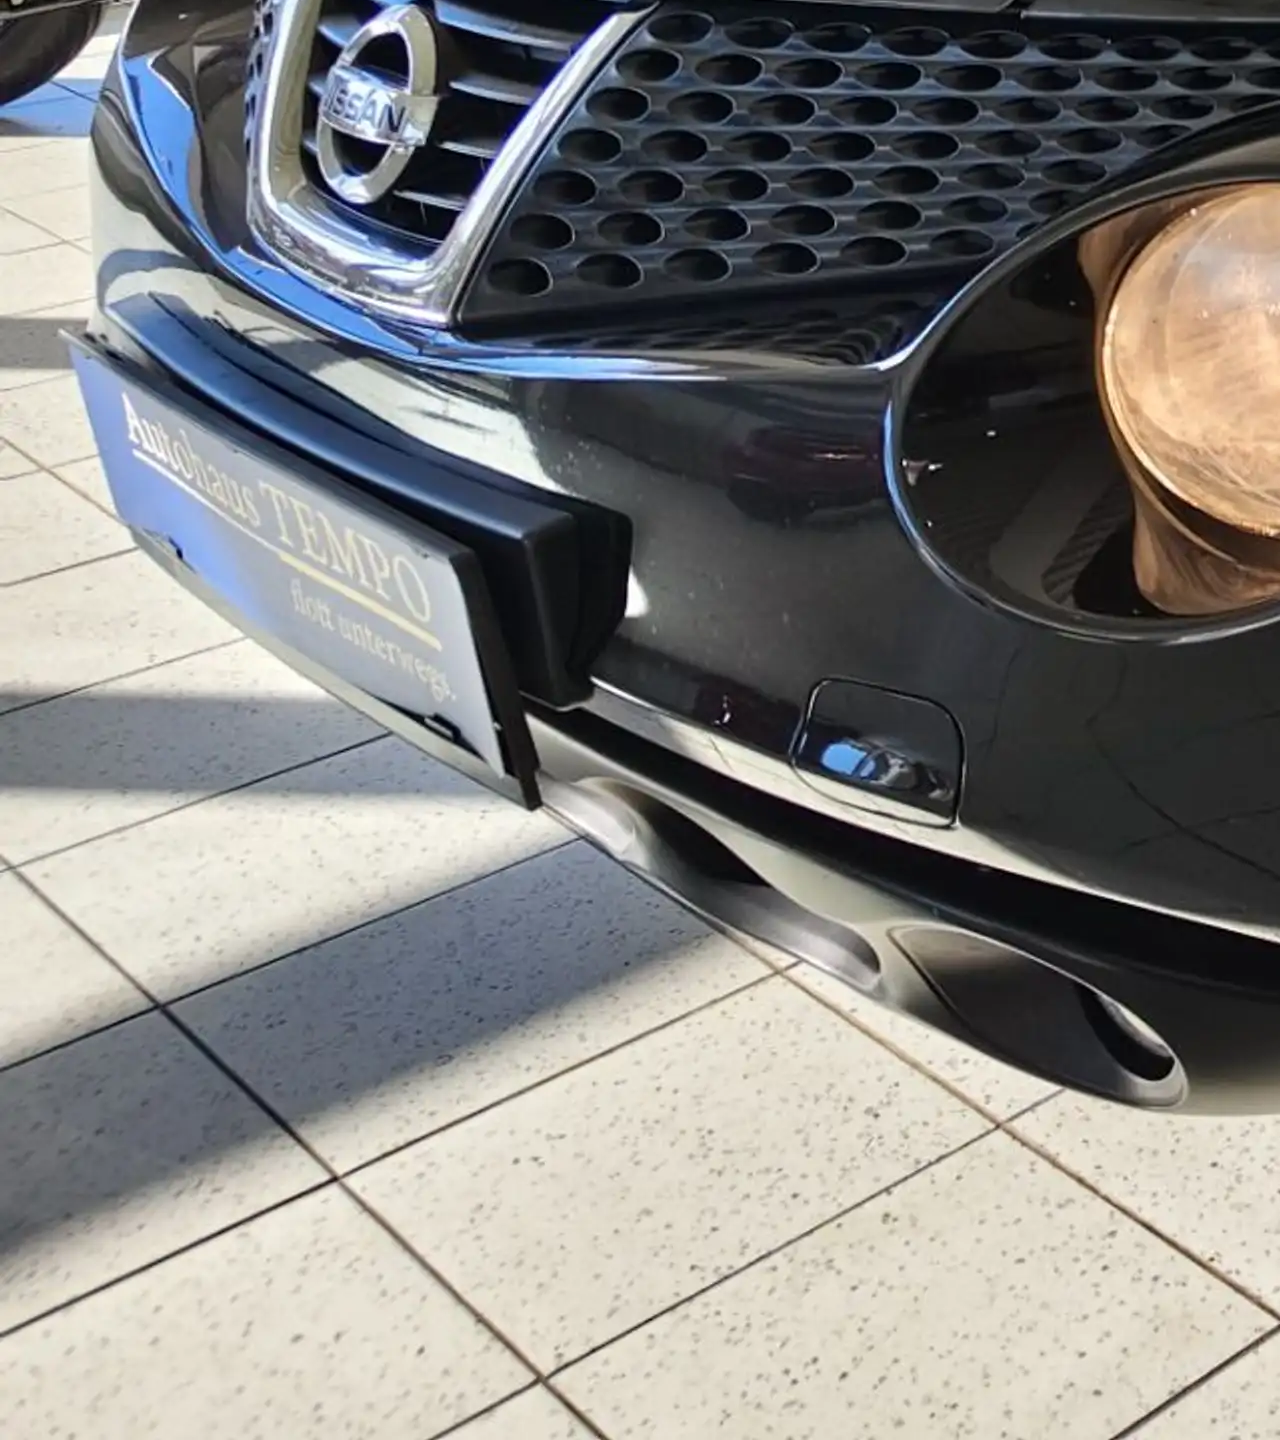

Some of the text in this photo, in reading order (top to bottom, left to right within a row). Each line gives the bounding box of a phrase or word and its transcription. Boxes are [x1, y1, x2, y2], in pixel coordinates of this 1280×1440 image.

[121, 392, 431, 623] Autohaus TEMPO
[290, 578, 336, 631] flott
